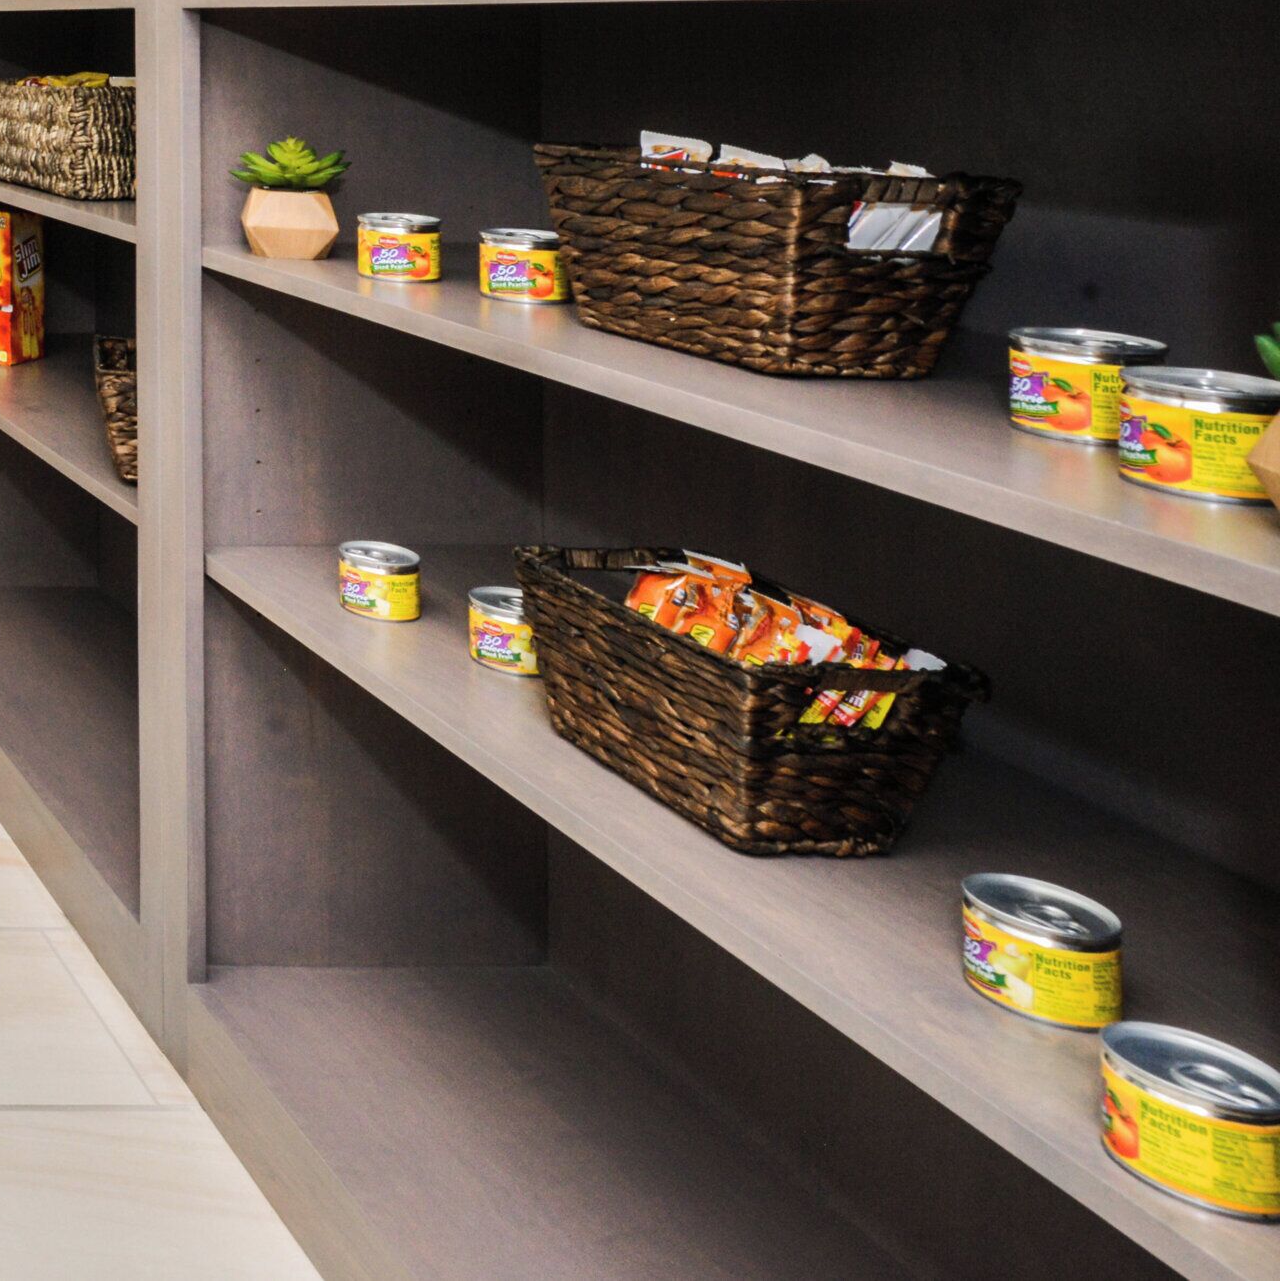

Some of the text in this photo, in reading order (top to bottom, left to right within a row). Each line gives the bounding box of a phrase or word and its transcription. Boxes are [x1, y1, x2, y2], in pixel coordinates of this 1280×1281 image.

[380, 249, 399, 258] 50
[496, 265, 517, 275] 50
[1011, 376, 1031, 391] 50
[1193, 418, 1260, 436] Nutrition
[1194, 429, 1237, 445] Facts
[346, 581, 360, 593] 50
[483, 634, 502, 646] 50
[1035, 952, 1090, 972] Nutrition
[1035, 962, 1072, 980] Facts
[1140, 1100, 1208, 1136] Nutrition
[1140, 1110, 1182, 1139] Facts
